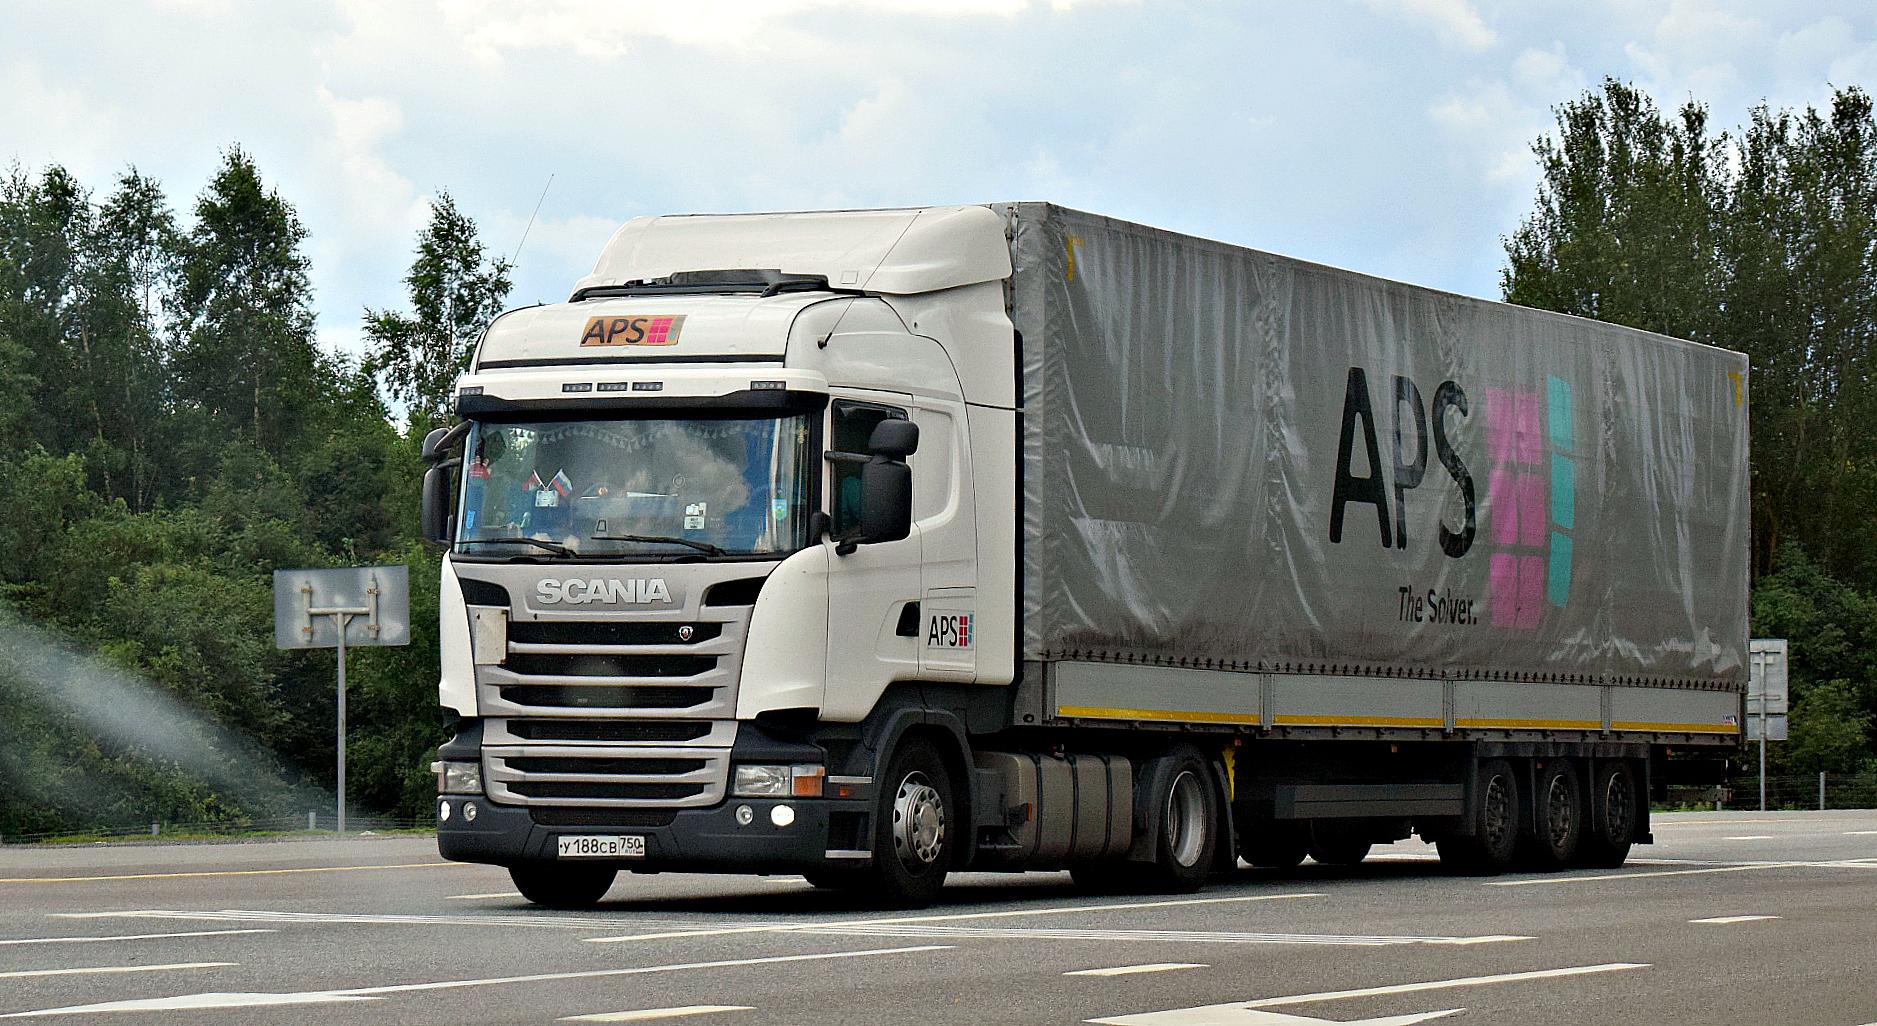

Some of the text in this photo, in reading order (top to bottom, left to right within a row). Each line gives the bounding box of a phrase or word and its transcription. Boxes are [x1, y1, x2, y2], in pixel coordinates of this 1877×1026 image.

[581, 318, 648, 344] APS
[1329, 366, 1477, 558] APS
[536, 578, 672, 604] SCANIA
[1399, 585, 1477, 625] The Solver.
[928, 615, 958, 647] APS
[620, 838, 641, 849] 750
